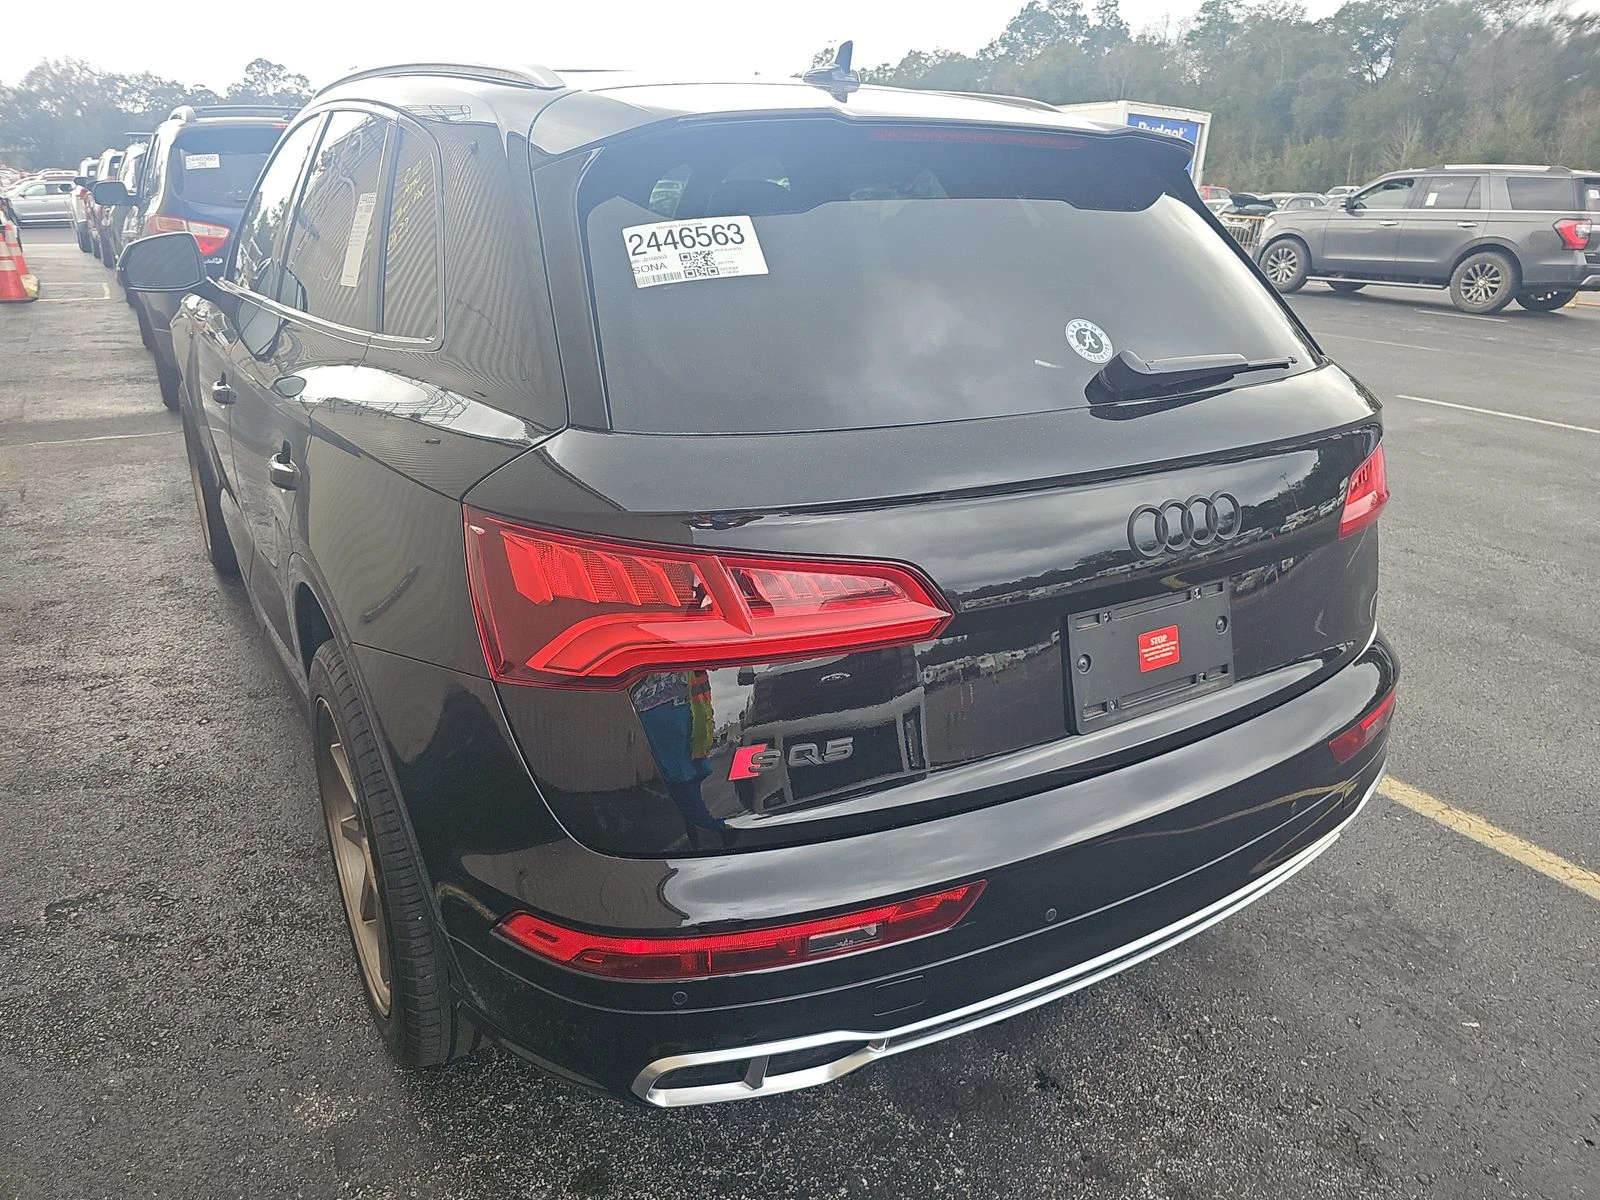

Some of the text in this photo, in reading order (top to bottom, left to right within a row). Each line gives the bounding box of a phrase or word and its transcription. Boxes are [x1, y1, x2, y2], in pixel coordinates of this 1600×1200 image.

[628, 223, 745, 256] 2446563
[633, 262, 668, 275] SONA
[1150, 634, 1168, 646] STOP
[747, 736, 854, 773] SQ5
